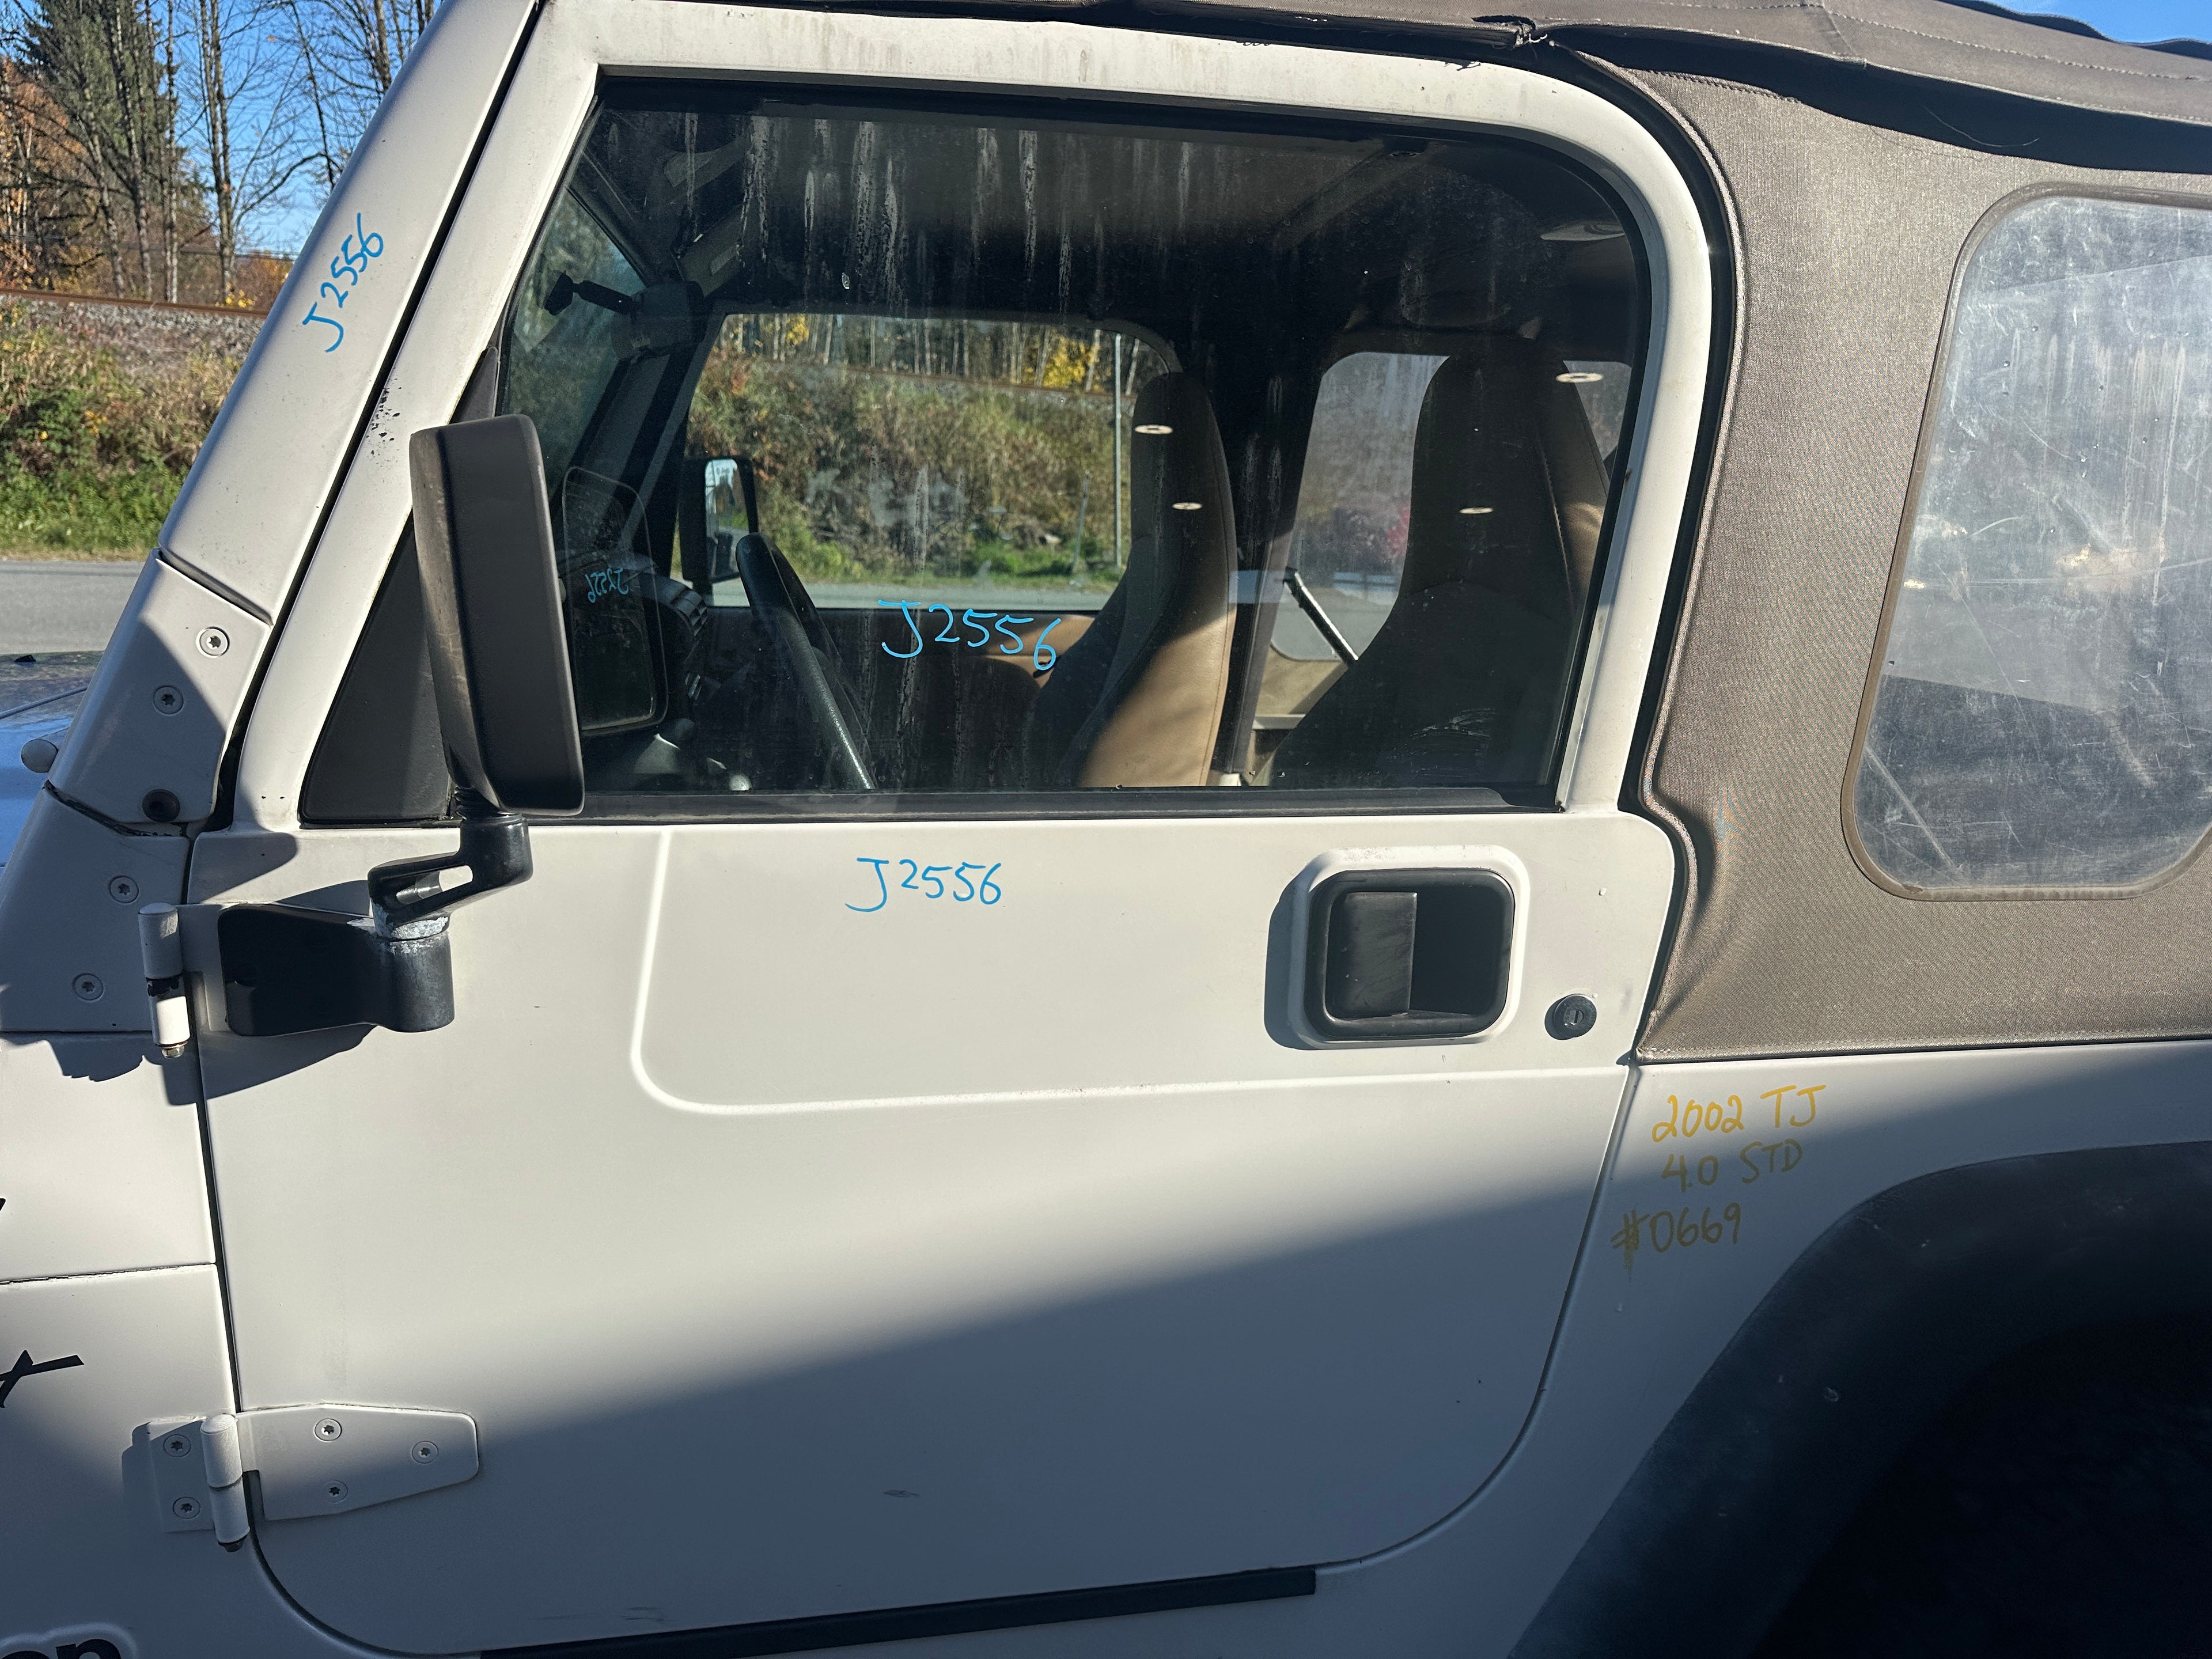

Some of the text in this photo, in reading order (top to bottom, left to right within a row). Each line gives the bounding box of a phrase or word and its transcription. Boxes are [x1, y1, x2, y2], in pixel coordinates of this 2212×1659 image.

[302, 213, 383, 353] J2556
[878, 600, 1061, 670] J2556
[845, 857, 1001, 912] J2556
[1652, 1085, 1826, 1142] 2002 TJ
[1661, 1138, 1802, 1192] 4.0 STD
[1611, 1202, 1741, 1263] #0669
